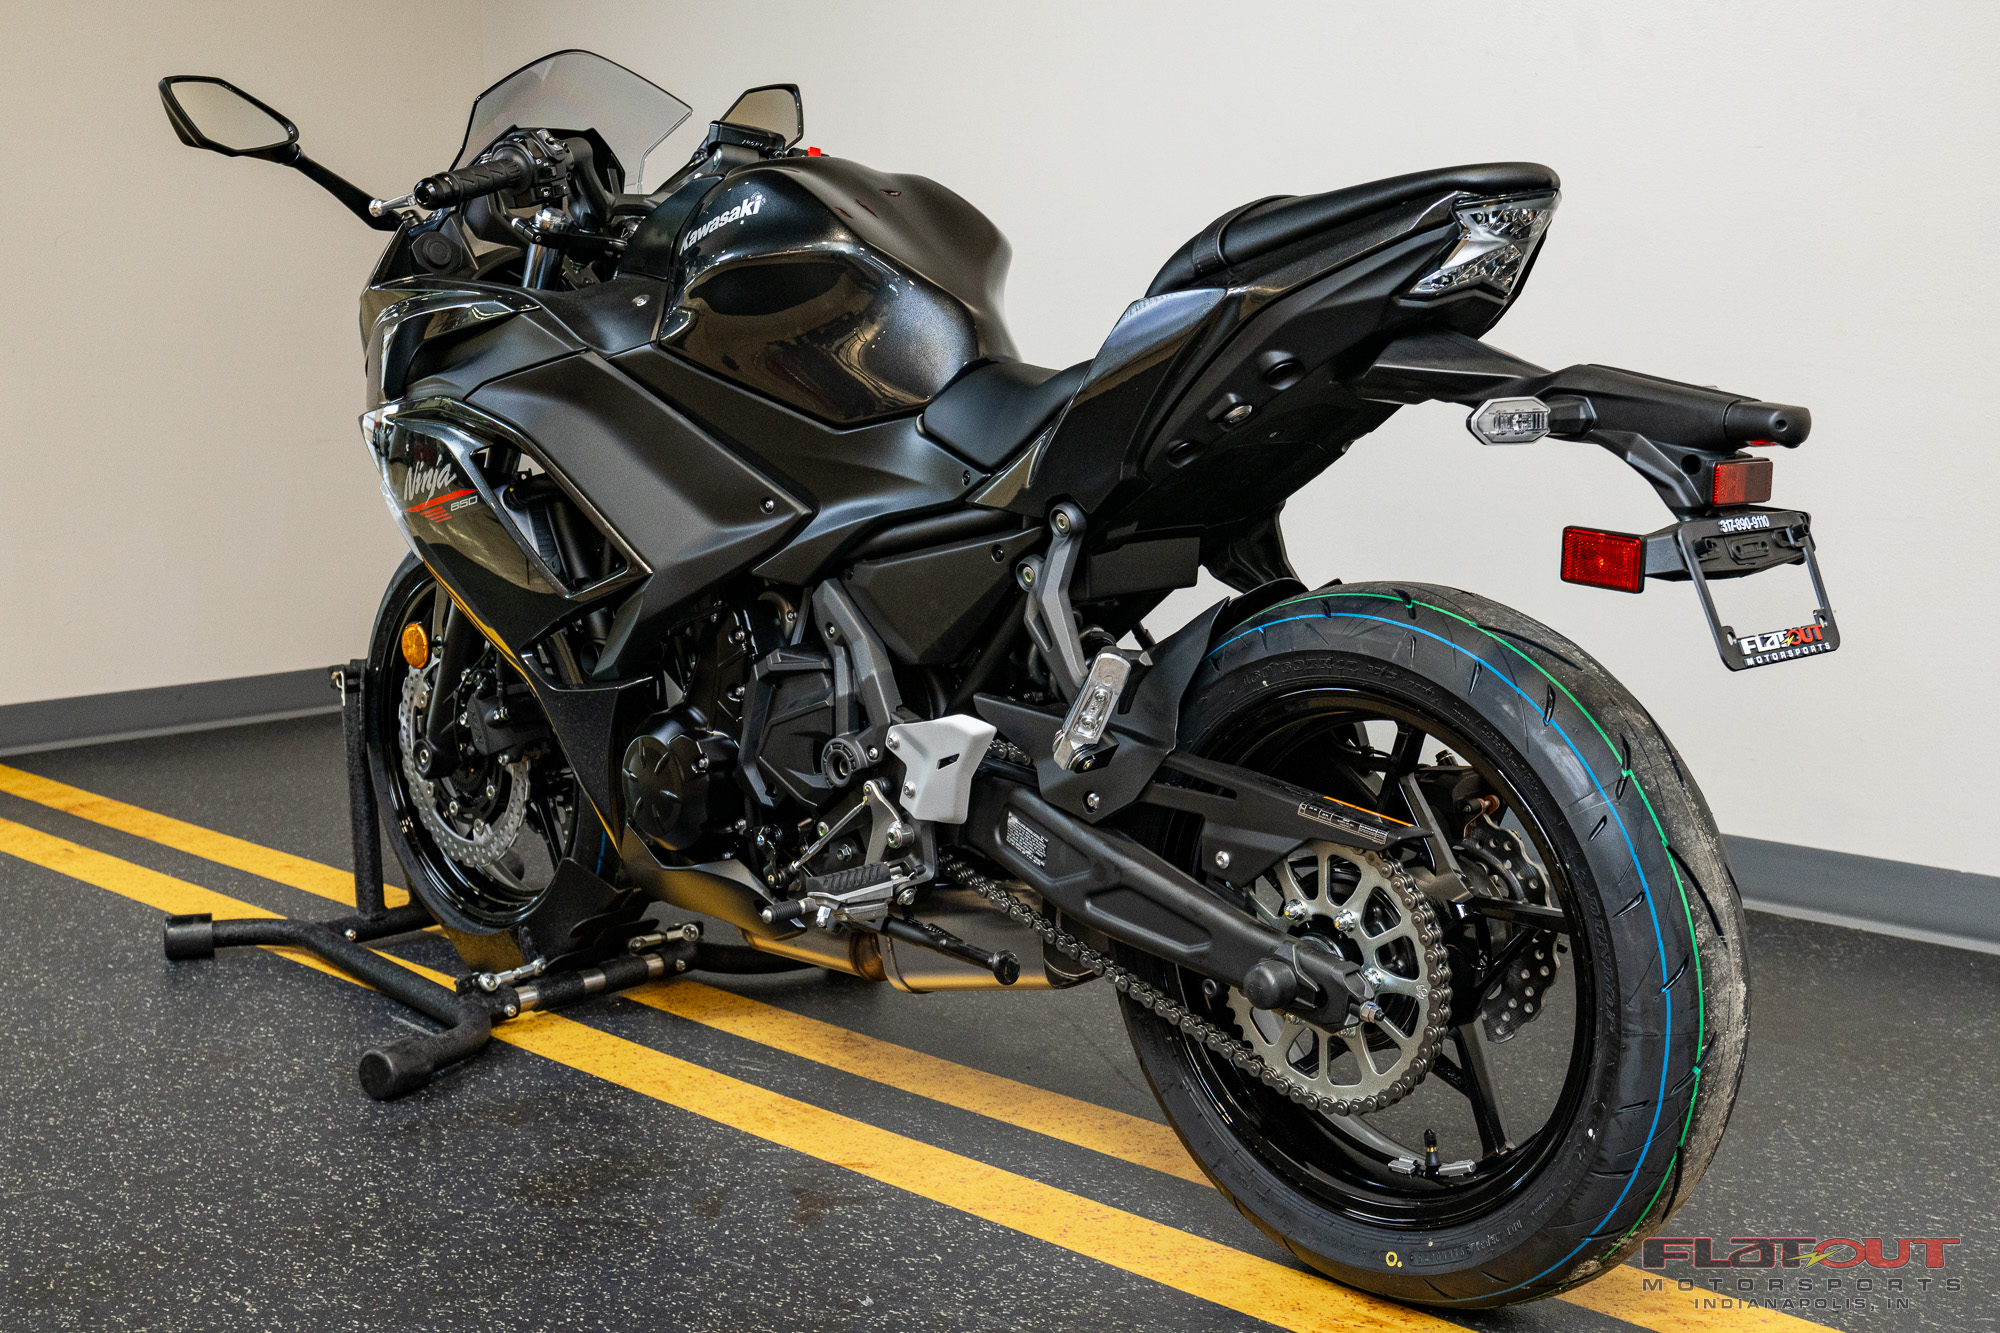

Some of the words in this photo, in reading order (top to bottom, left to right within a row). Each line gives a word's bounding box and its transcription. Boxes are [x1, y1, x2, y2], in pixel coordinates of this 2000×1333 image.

[680, 194, 762, 255] Kawasaki
[404, 454, 457, 506] Ninja
[450, 496, 478, 511] 650
[1719, 515, 1770, 533] 317-890-9110
[1744, 643, 1831, 666] MOTORSPORTS
